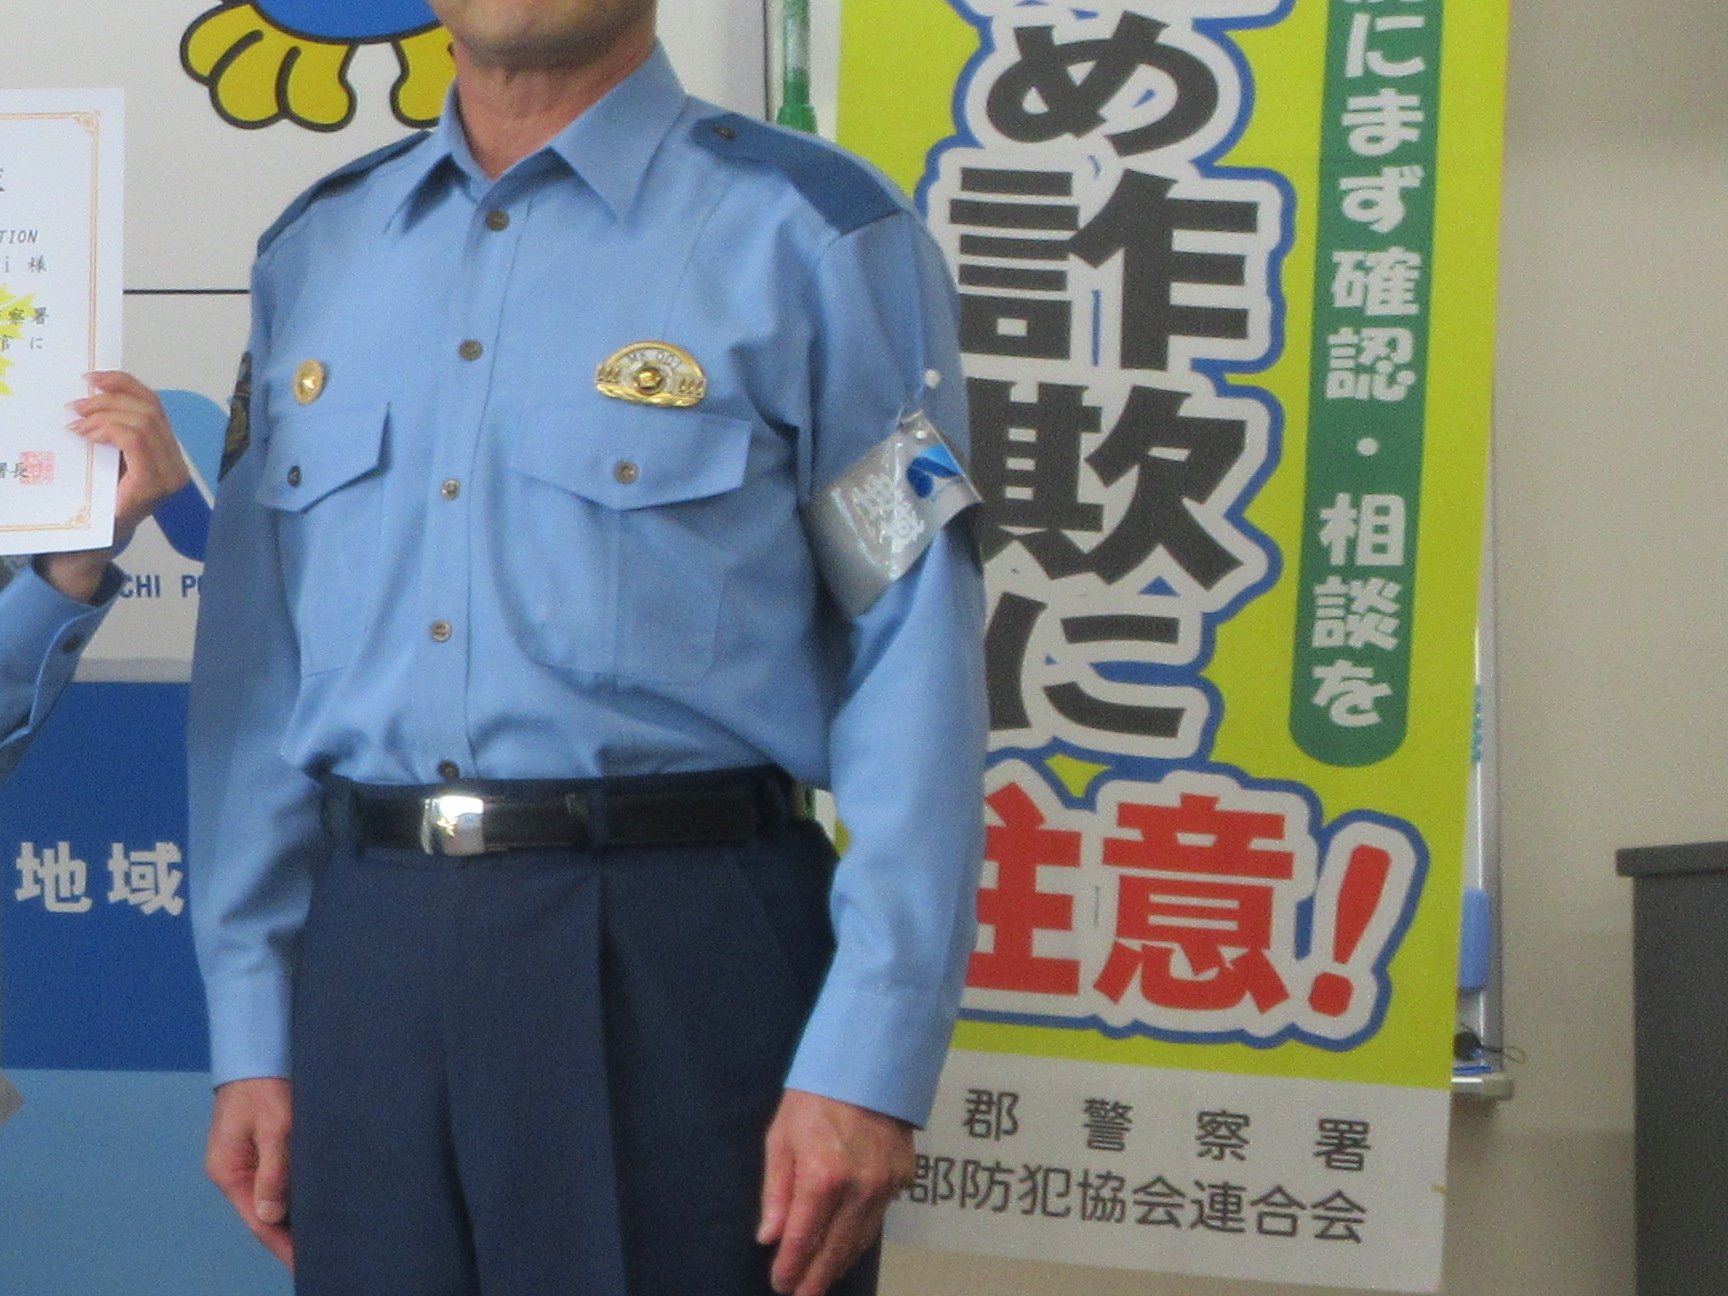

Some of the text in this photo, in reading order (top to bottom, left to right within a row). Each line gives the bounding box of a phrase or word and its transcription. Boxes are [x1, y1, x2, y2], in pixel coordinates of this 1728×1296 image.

[27, 256, 47, 274] 様
[120, 574, 161, 599] CHI
[15, 841, 185, 917] 地域
[963, 1087, 1371, 1174] 郡警察署
[910, 1156, 1367, 1245] 郡防犯協会連合会
